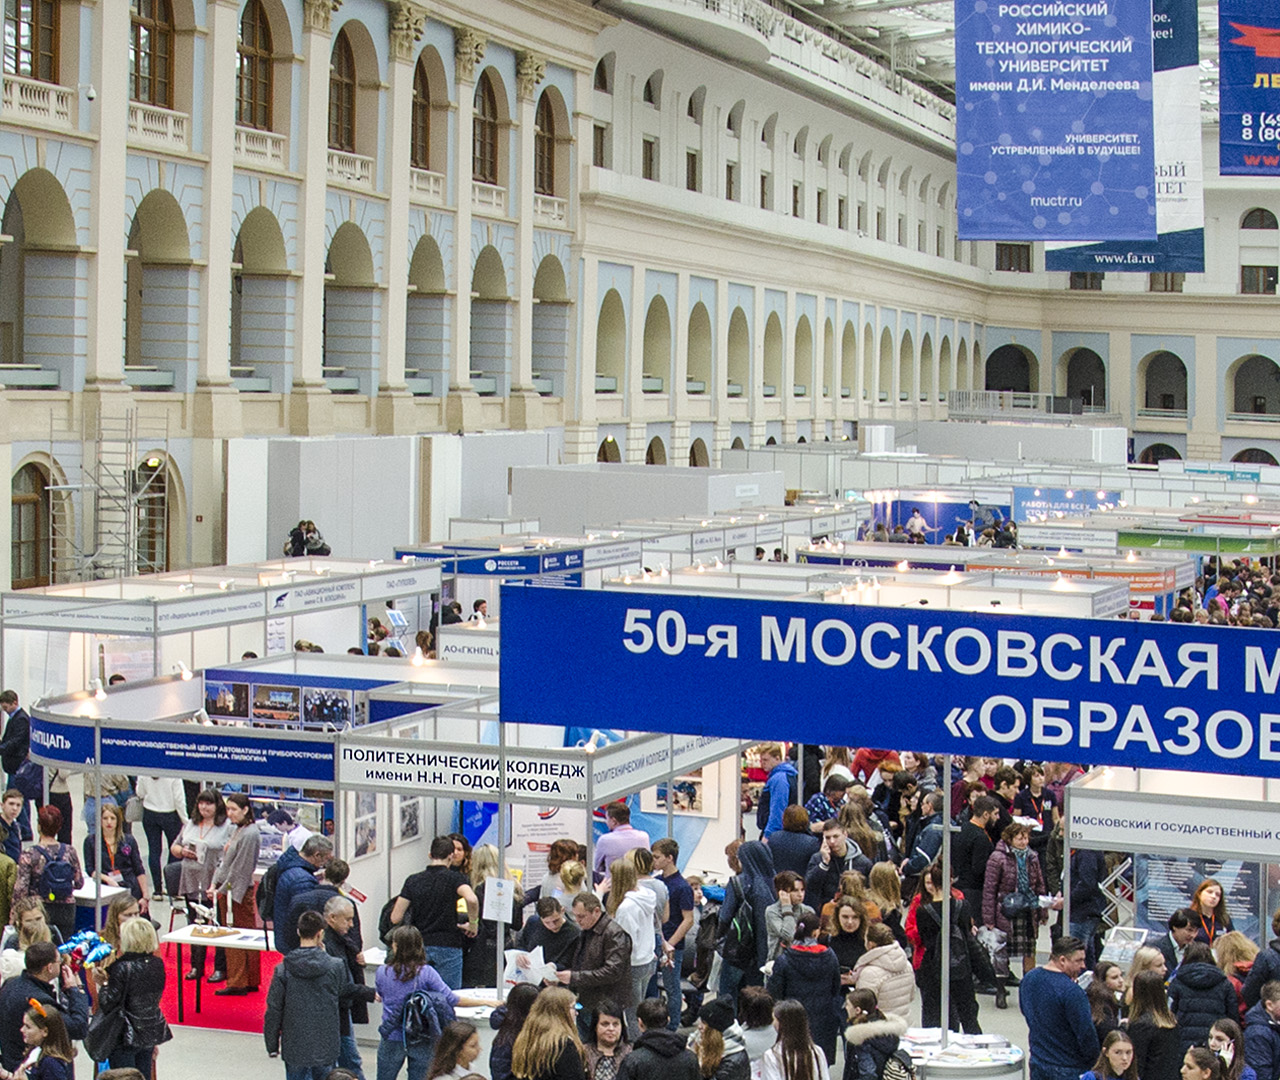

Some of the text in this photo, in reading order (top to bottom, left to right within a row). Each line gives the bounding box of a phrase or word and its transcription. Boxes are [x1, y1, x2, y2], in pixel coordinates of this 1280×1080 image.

[999, 1, 1108, 17] РОССИЙСКИЙ
[1016, 20, 1091, 36] ХИМИКО-
[976, 39, 1132, 53] ТЕХНОЛОГИЧЕСКИЙ
[999, 58, 1108, 73] УНИВЕРСИТЕТ
[970, 77, 1139, 93] имени Д.И. Менделеева
[1242, 114, 1252, 126] 8
[1065, 134, 1140, 145] УНИВЕРСИТЕТ,
[1242, 128, 1252, 140] 8
[991, 144, 1140, 157] УСТРЕМЛЕННЫЙ В БУДУЩЕЕ!
[1031, 194, 1082, 207] muctr.ru
[1094, 252, 1154, 264] www.fa.ru
[622, 608, 738, 658] 50-я
[761, 615, 1219, 691] МОСКОВСКАЯ
[198, 744, 218, 752] ЦЕНТР
[506, 760, 585, 778] КОЛЛЕДЖ
[365, 769, 412, 782] имени
[417, 770, 447, 785] Н.Н.
[1072, 815, 1151, 830] МОСКОВСКИЙ
[1154, 822, 1272, 839] ГОСУДАРСТВЕННЫЙ
